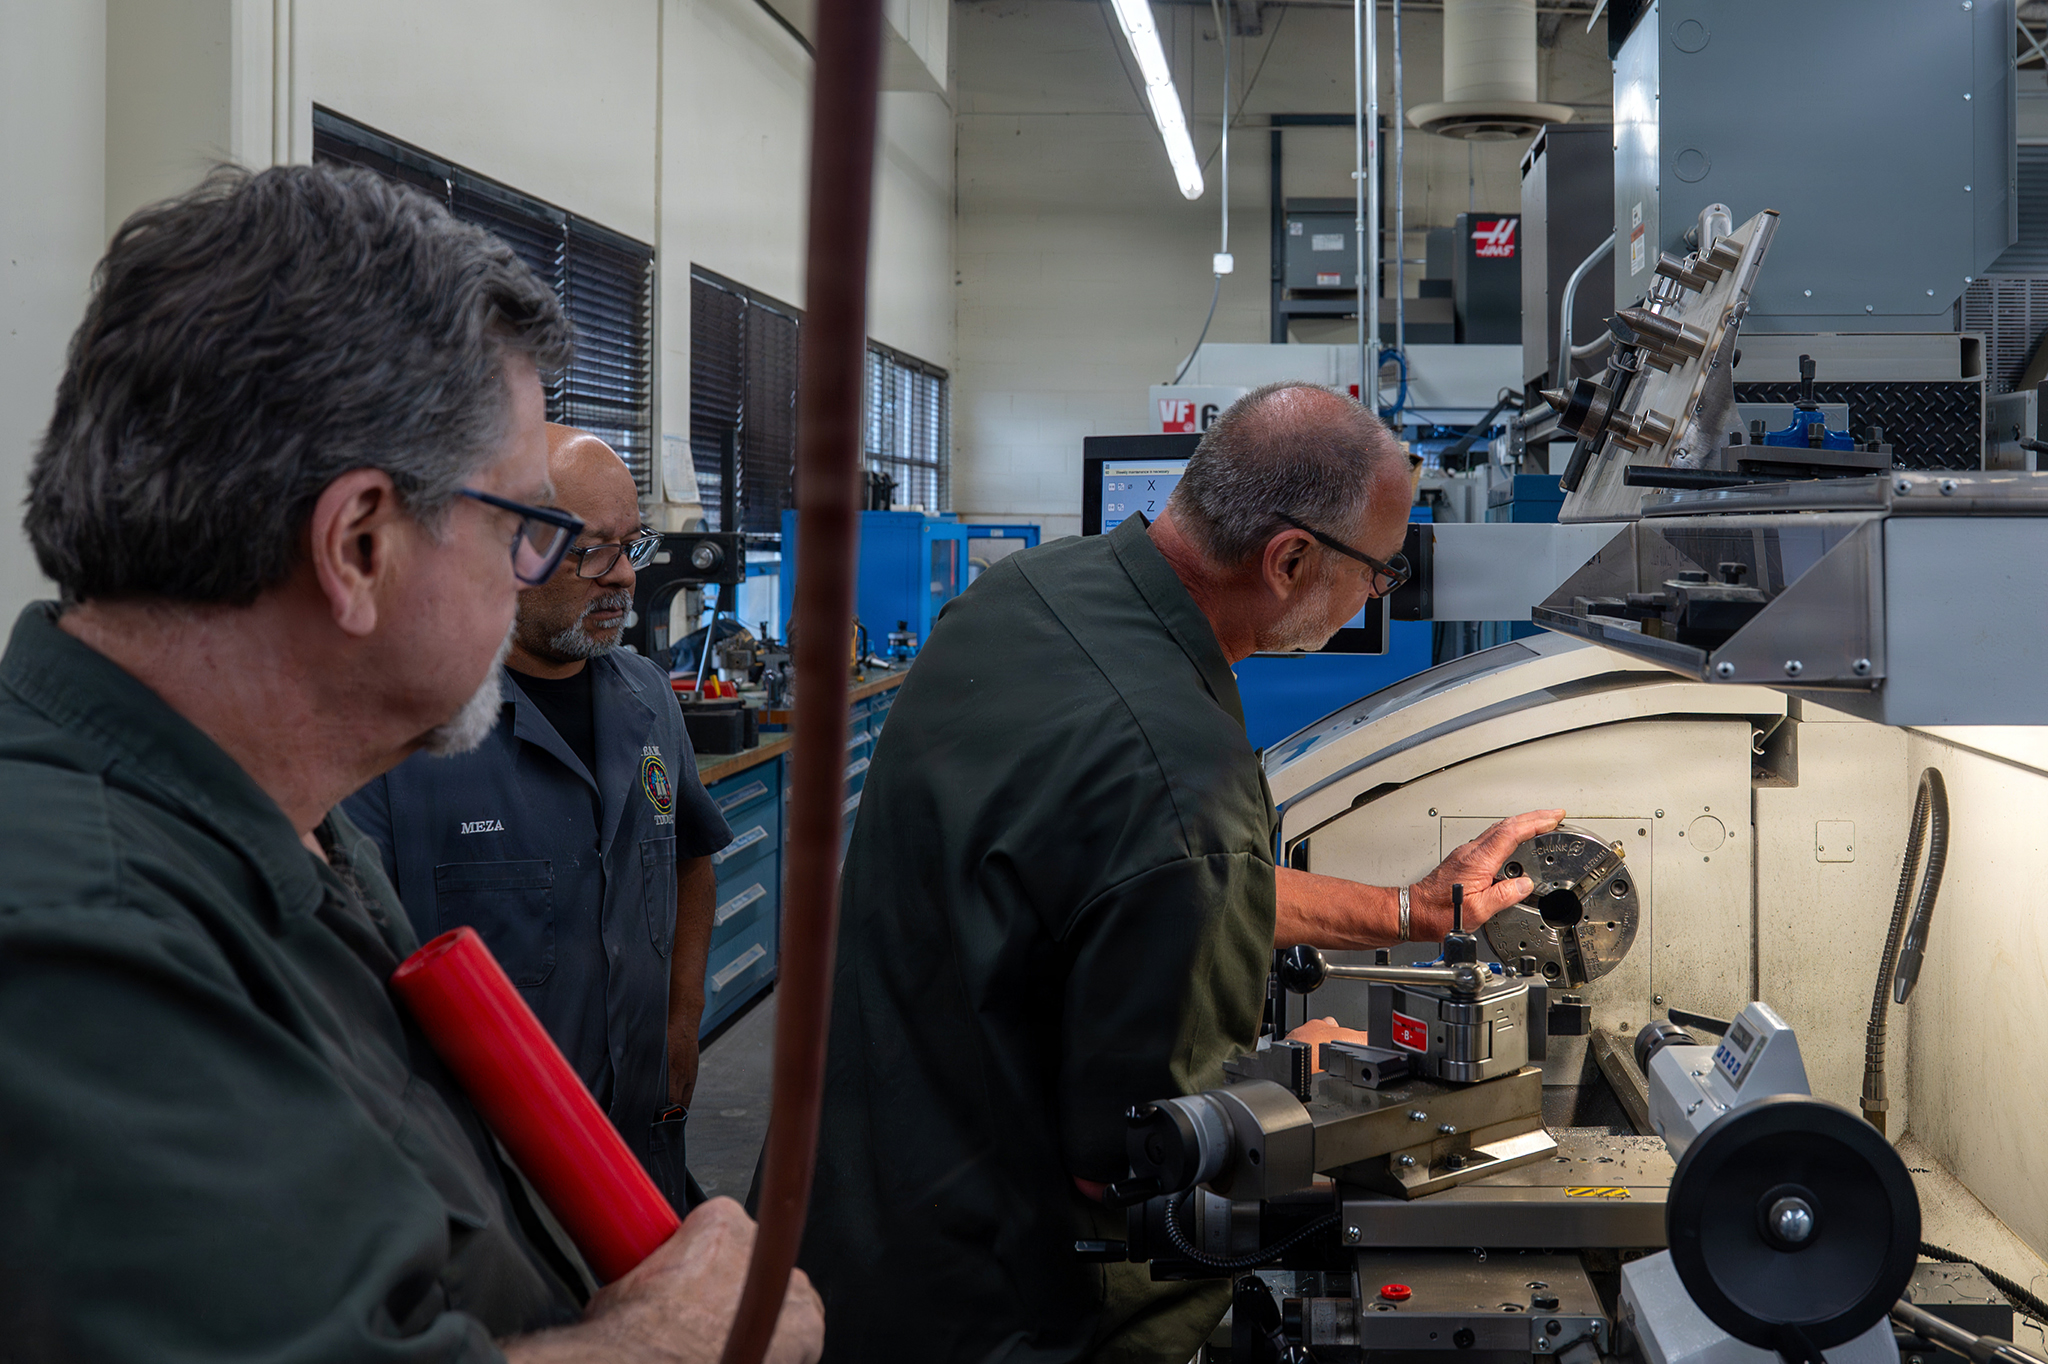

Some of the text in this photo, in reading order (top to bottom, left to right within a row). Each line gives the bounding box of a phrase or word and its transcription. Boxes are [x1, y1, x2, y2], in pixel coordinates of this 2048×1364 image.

[1475, 244, 1515, 256] HAAS
[1159, 399, 1219, 431] VF 6
[1147, 480, 1156, 491] X
[1146, 500, 1155, 512] Z
[460, 819, 505, 835] MEZA
[1531, 843, 1568, 858] SCHUNK
